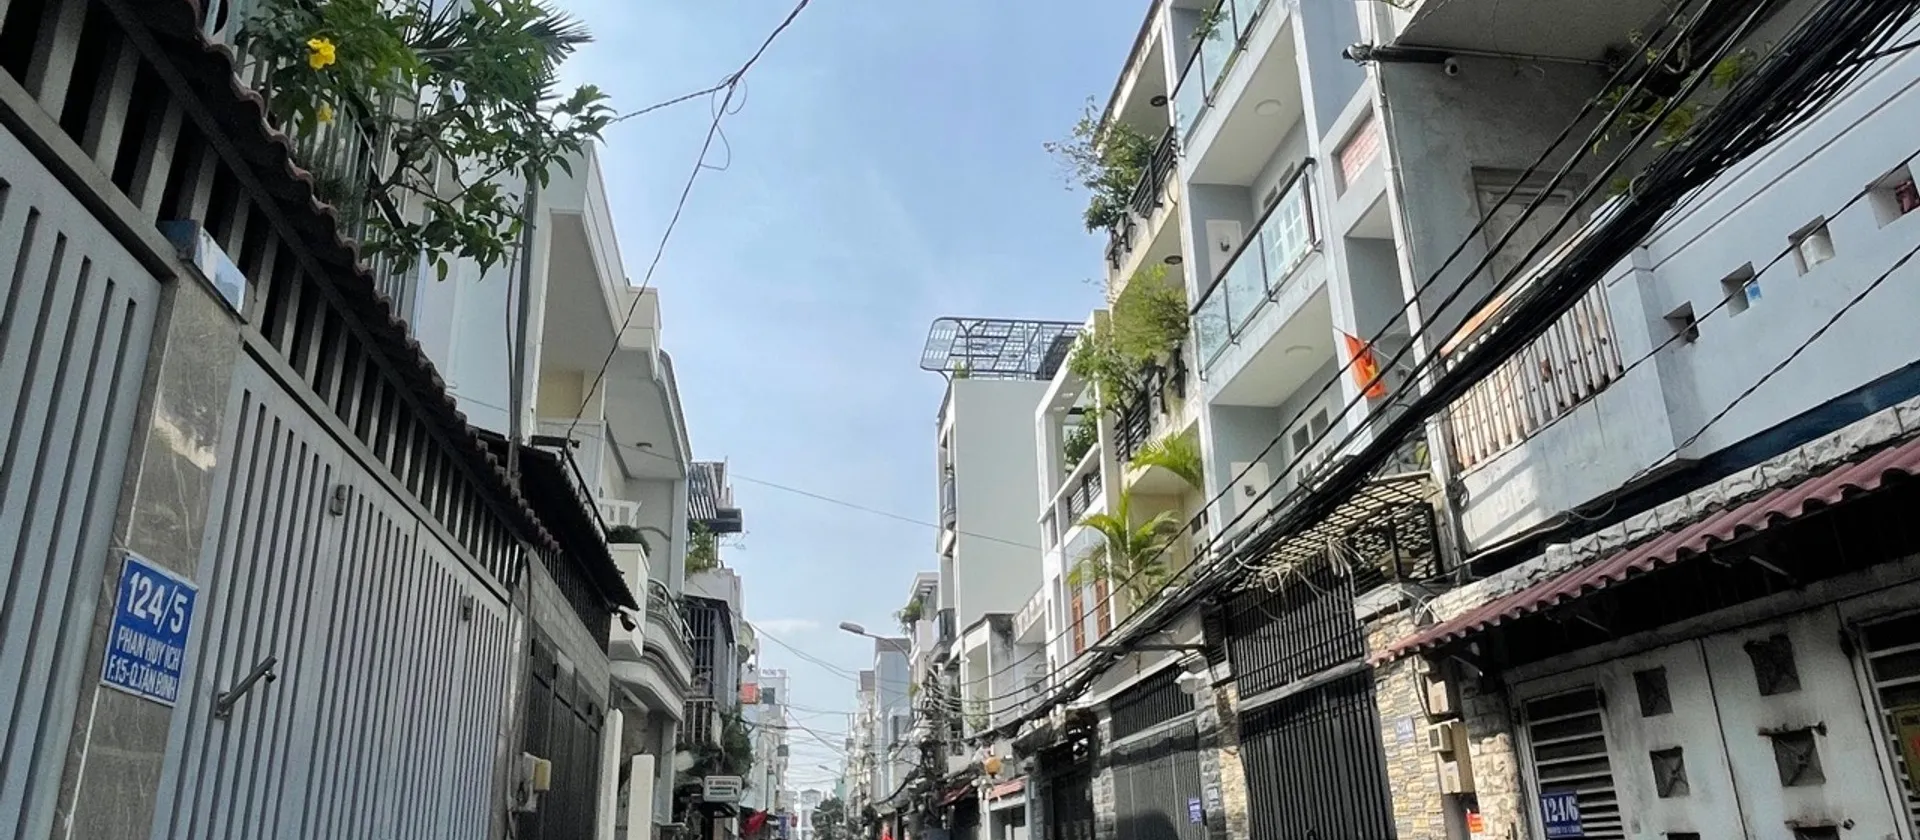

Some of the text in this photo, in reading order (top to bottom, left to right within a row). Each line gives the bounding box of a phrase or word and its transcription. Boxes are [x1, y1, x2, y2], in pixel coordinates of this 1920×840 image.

[127, 571, 188, 633] 124/5
[116, 625, 146, 658] PHAN
[145, 637, 166, 666] HUY
[1543, 796, 1578, 822] 124/6
